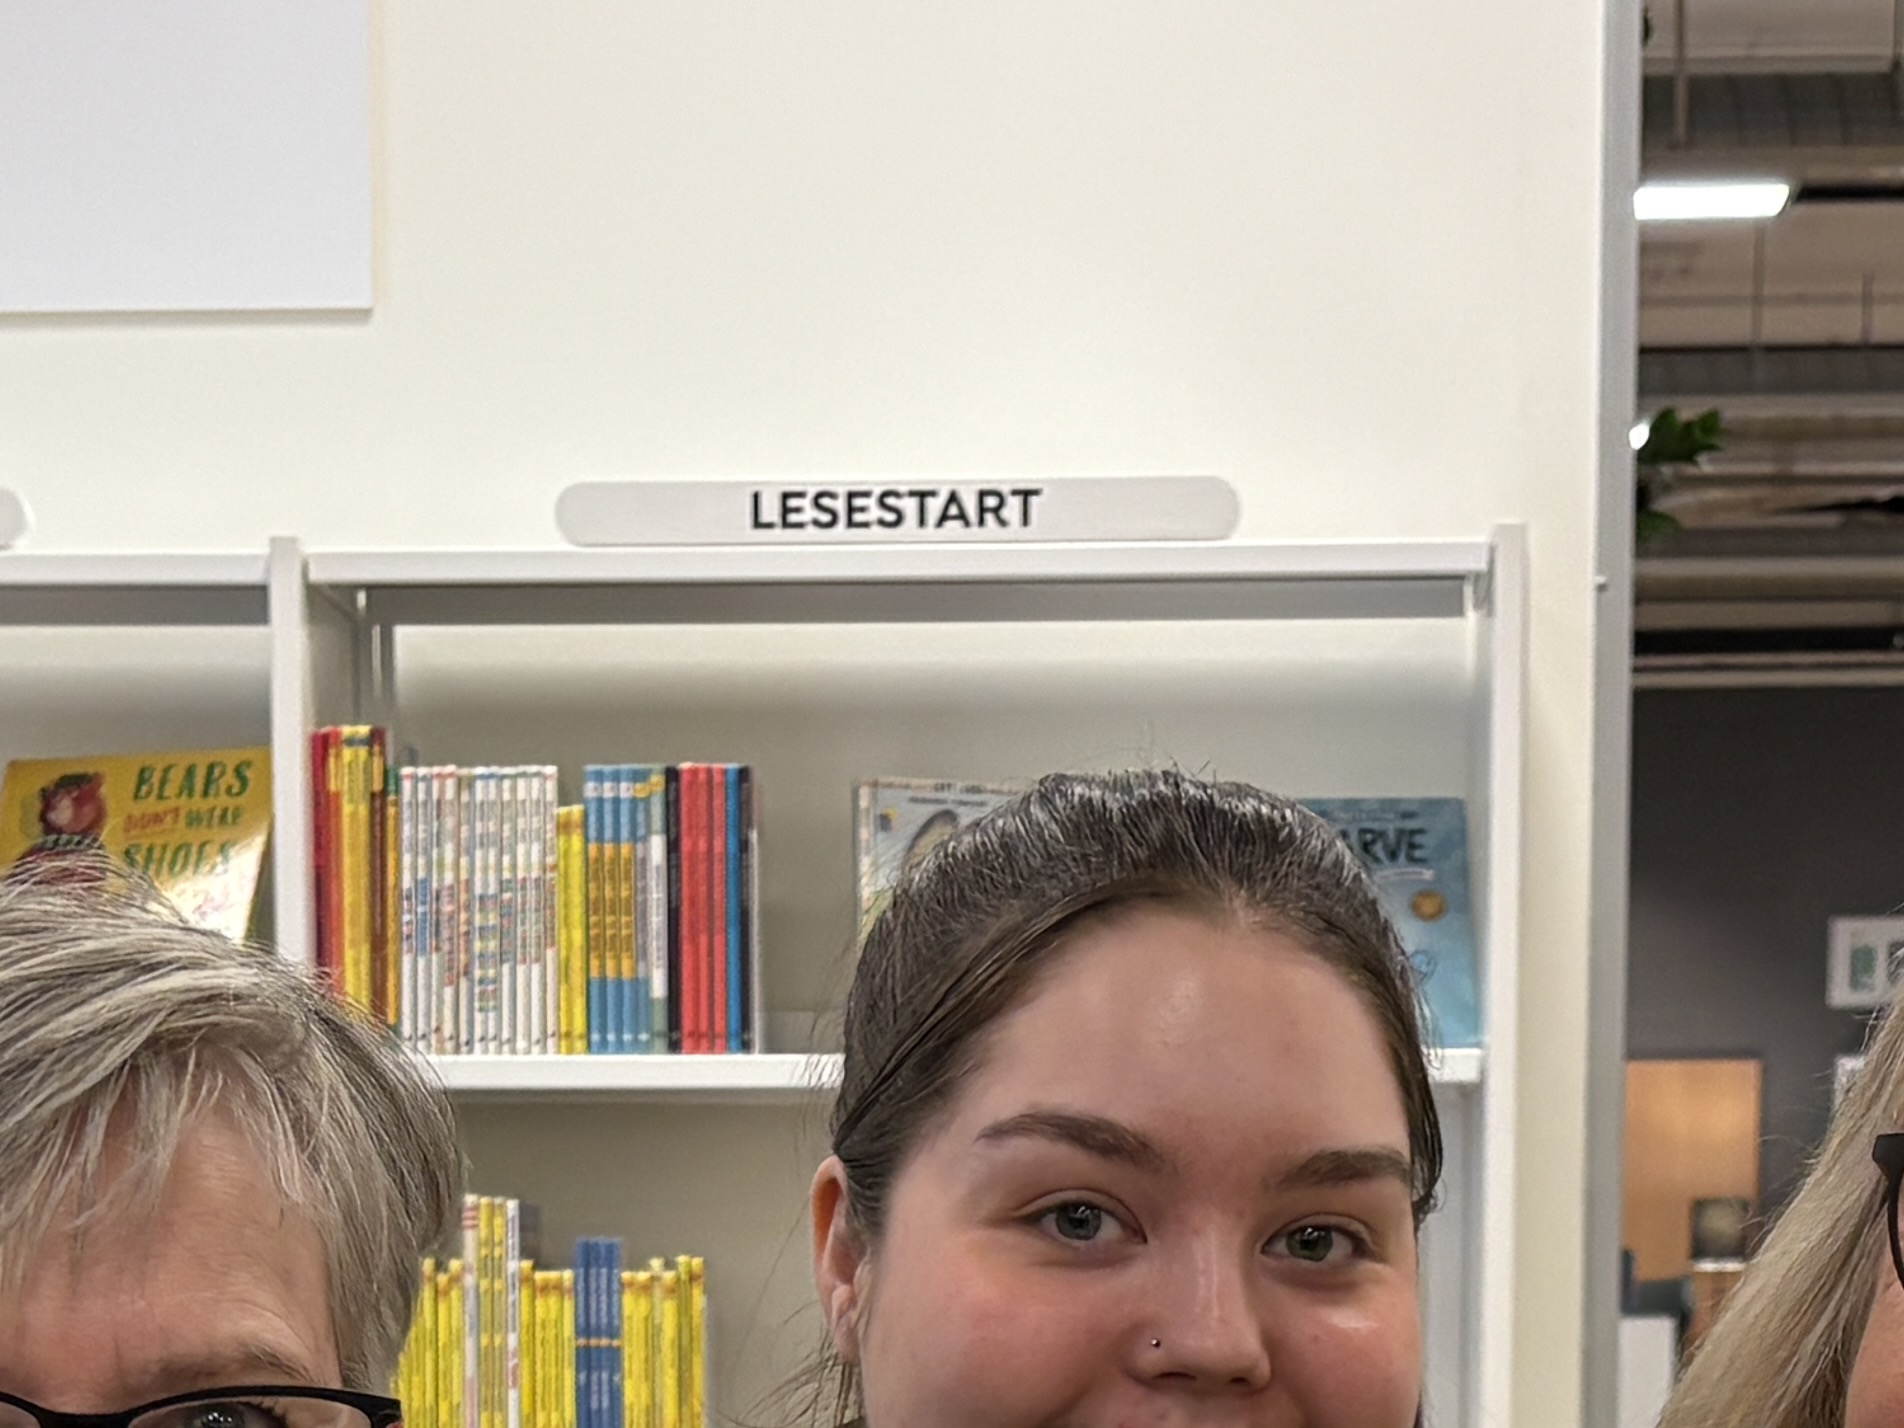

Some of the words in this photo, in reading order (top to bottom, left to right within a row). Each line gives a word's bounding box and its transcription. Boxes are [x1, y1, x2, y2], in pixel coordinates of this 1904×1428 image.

[751, 488, 1043, 531] LESESTART
[133, 760, 253, 803] BEARS
[1339, 826, 1428, 863] RVE
